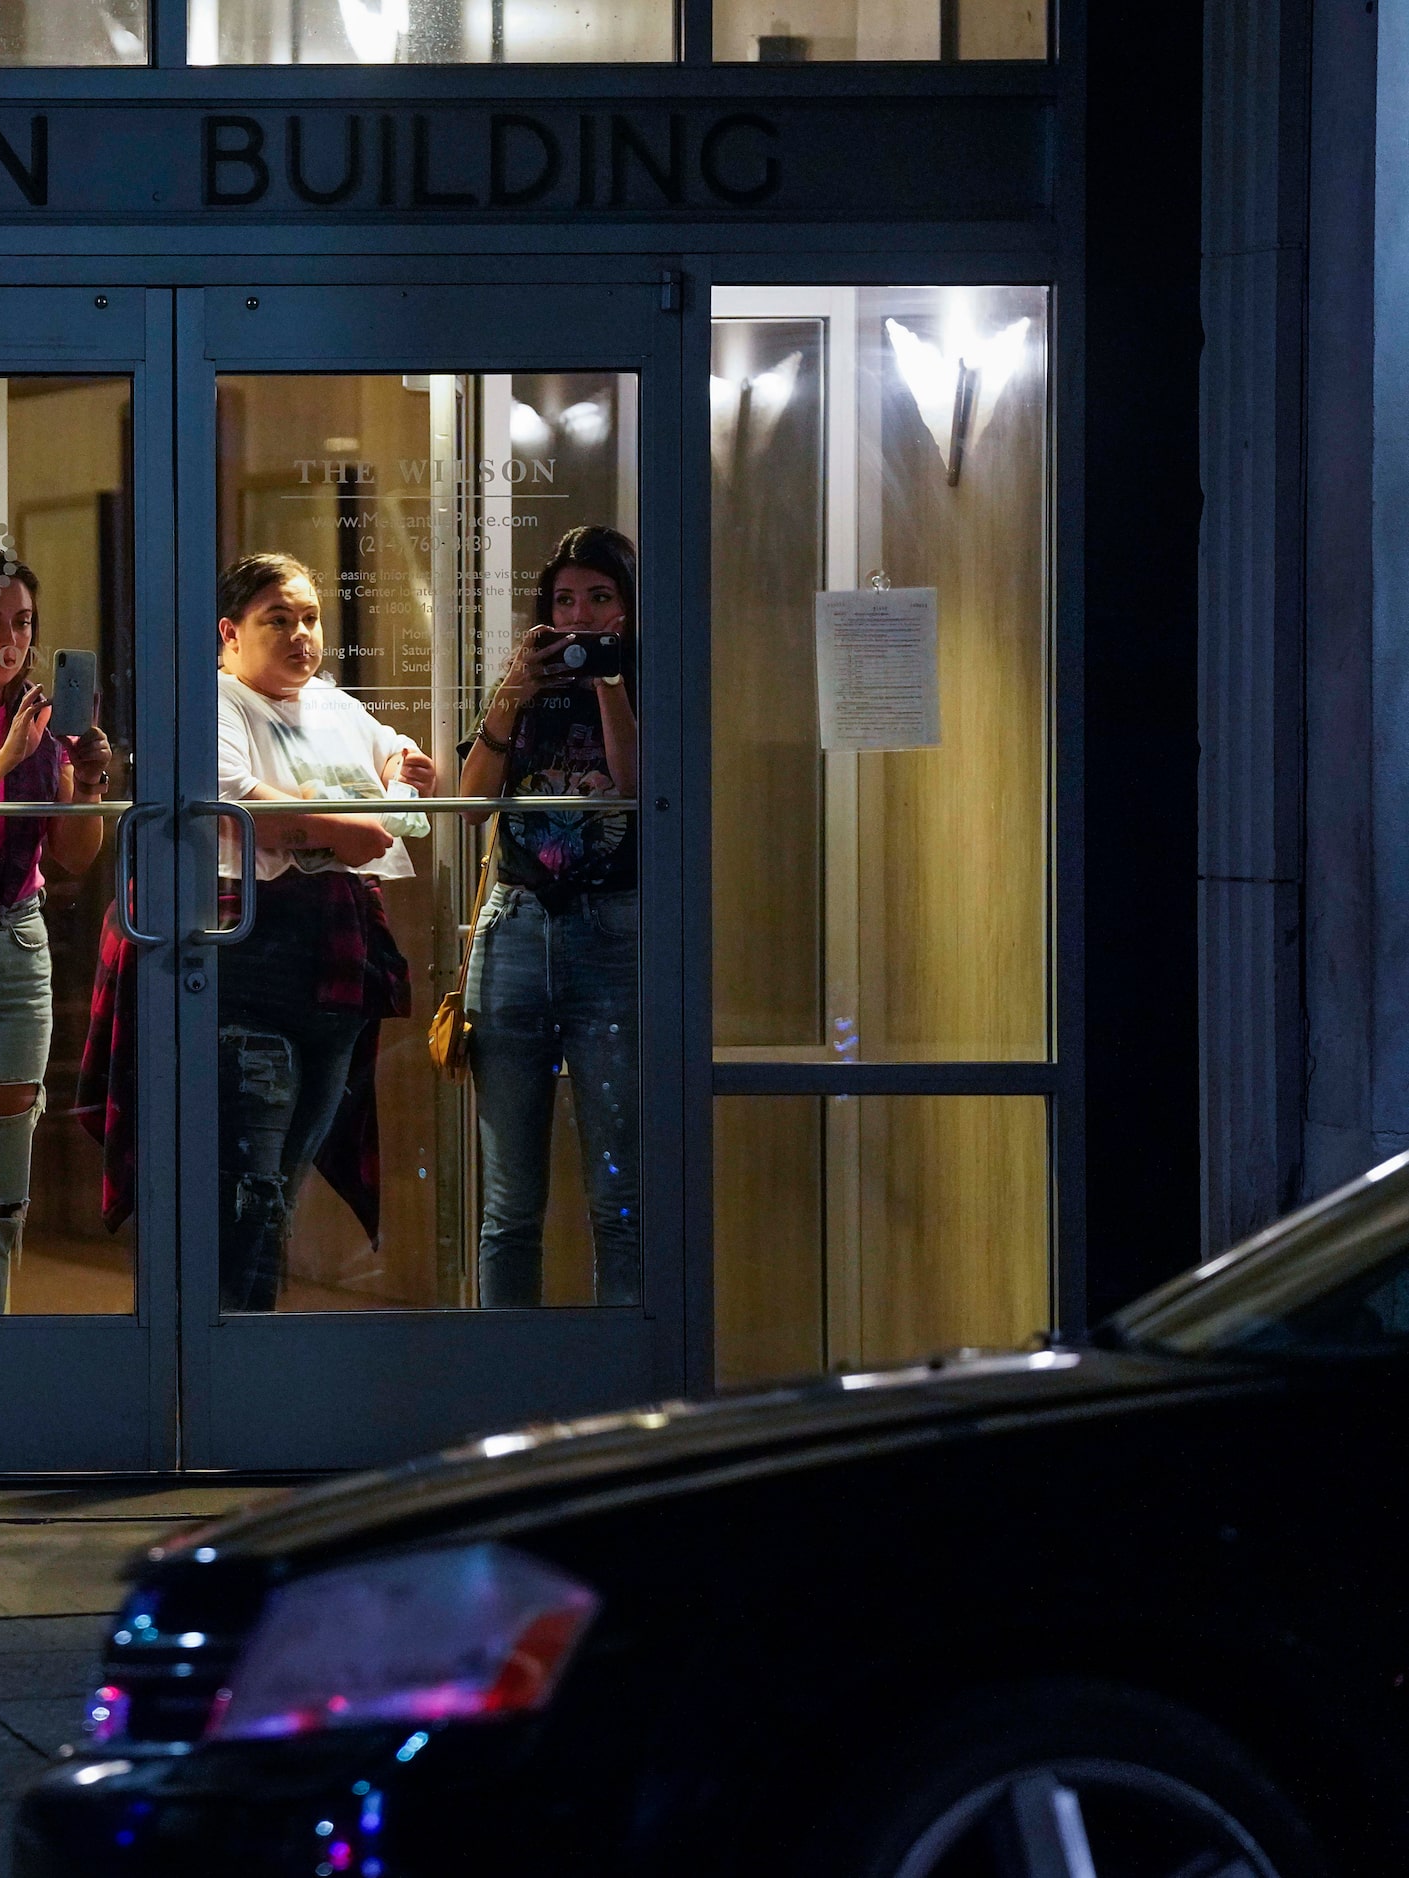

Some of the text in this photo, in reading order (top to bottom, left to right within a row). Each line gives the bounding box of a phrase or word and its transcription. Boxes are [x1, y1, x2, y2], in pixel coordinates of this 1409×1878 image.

[200, 112, 782, 206] BUILDING
[294, 458, 557, 484] THE WILSON
[312, 511, 538, 529] www.MecantPace.com
[334, 569, 377, 584] Leasing
[456, 569, 491, 583] pease
[495, 569, 517, 580] visit
[521, 571, 542, 580] our
[309, 585, 352, 600] Leasing
[355, 585, 395, 597] Center
[400, 585, 439, 597] loated
[485, 585, 505, 597] the
[508, 586, 543, 597] street
[369, 604, 380, 614] at
[416, 601, 441, 613] Man
[447, 601, 483, 613] Sreet
[469, 628, 495, 639] 9am
[498, 629, 510, 639] to
[514, 627, 542, 642] 6pm
[302, 645, 385, 660] Lesing Hours
[402, 643, 541, 658] Satur 10am to pm
[402, 661, 441, 674] Sund
[304, 699, 318, 711] all
[321, 699, 352, 711] other
[357, 699, 410, 714] inquiries,
[412, 698, 449, 713] plee
